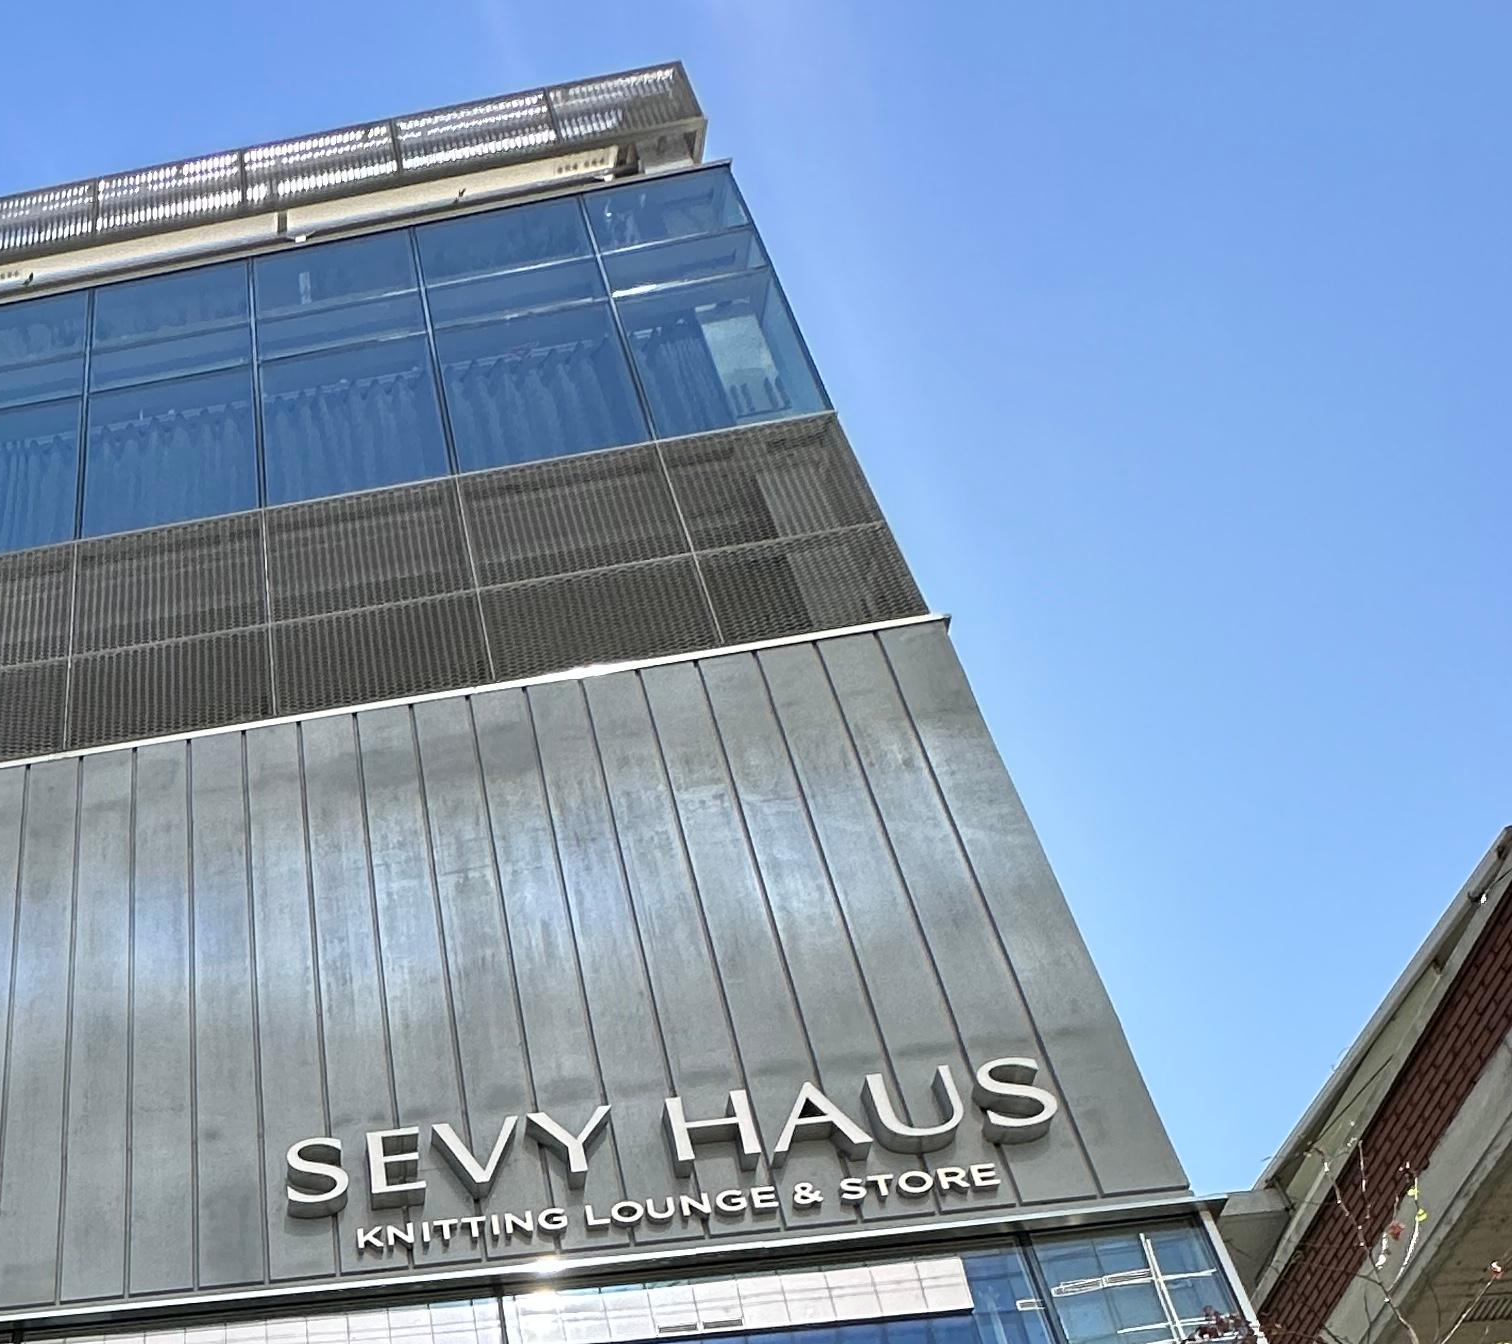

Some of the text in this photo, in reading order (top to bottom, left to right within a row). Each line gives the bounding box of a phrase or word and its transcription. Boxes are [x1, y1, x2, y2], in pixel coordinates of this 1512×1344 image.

[286, 1056, 1059, 1216] SEVY HAUS
[355, 1162, 1002, 1250] KNITTING LOUNGE & STORE
